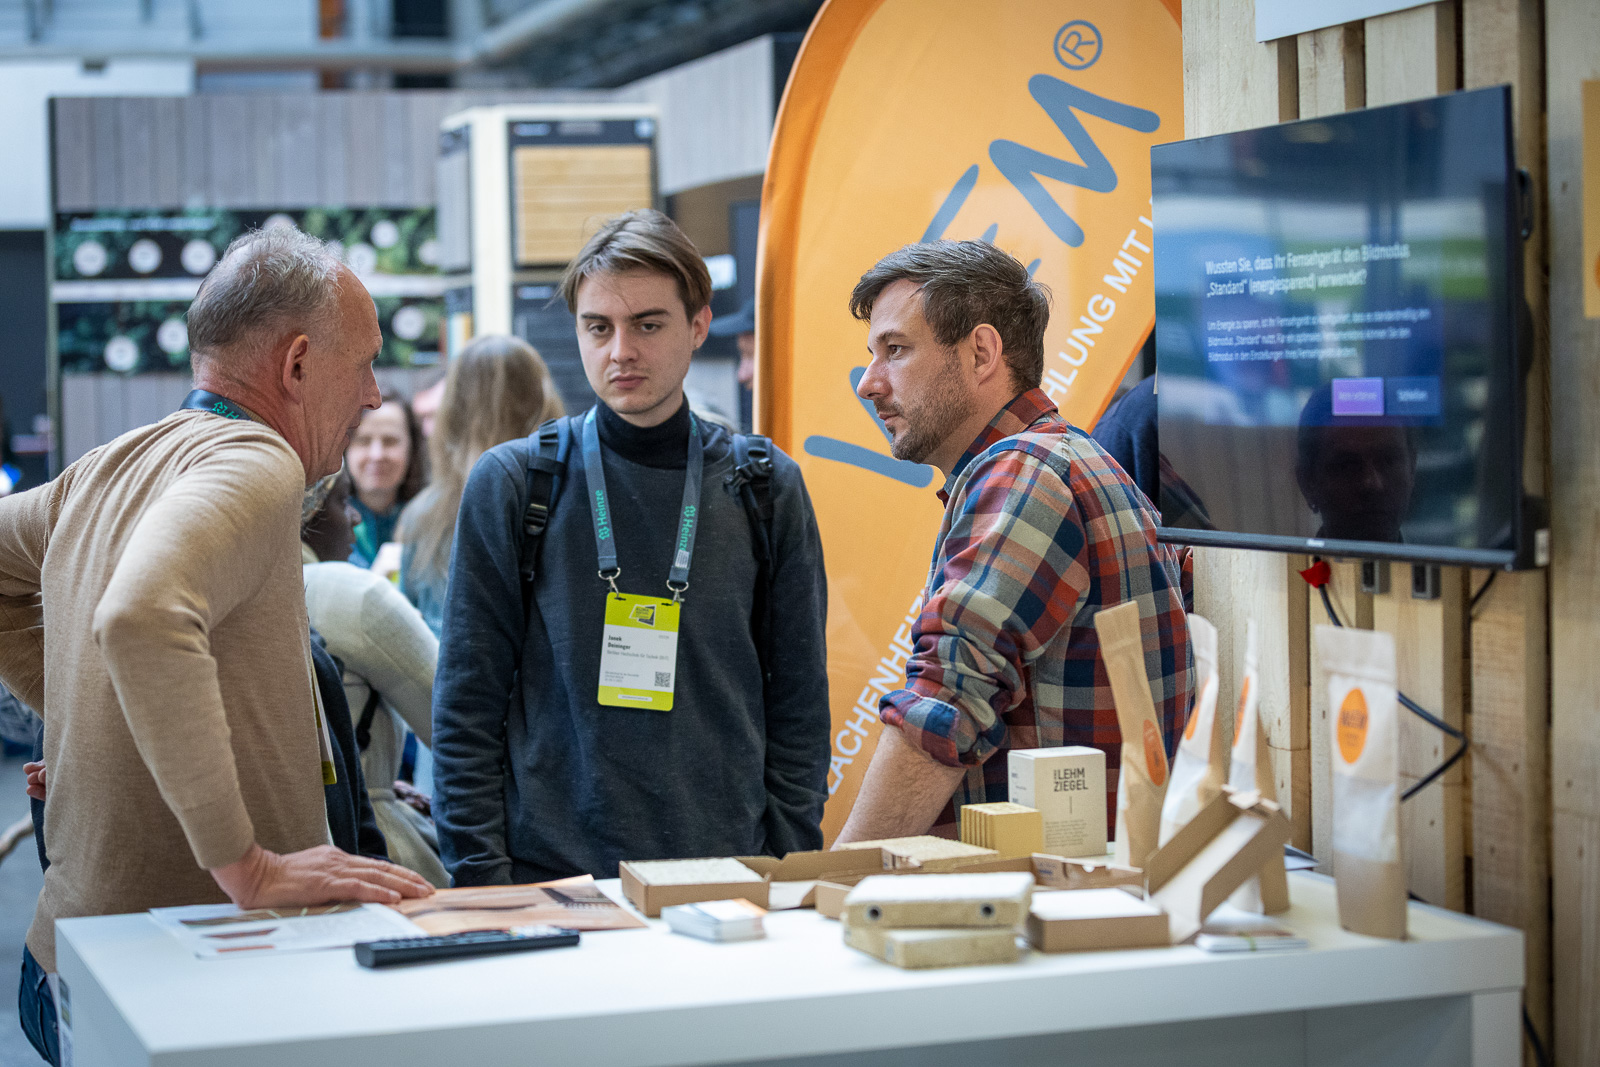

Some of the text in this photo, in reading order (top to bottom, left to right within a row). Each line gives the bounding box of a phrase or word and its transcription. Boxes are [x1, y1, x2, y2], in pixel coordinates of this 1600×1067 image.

[1103, 228, 1151, 294] MIT
[1205, 242, 1410, 275] Wussten Sie, dass Ihr Fernsehgerät den Bildmodus
[1317, 268, 1368, 288] verwendet?
[595, 489, 608, 527] Heinze
[1054, 780, 1088, 792] ZIEGEL
[1058, 768, 1086, 780] LEHM
